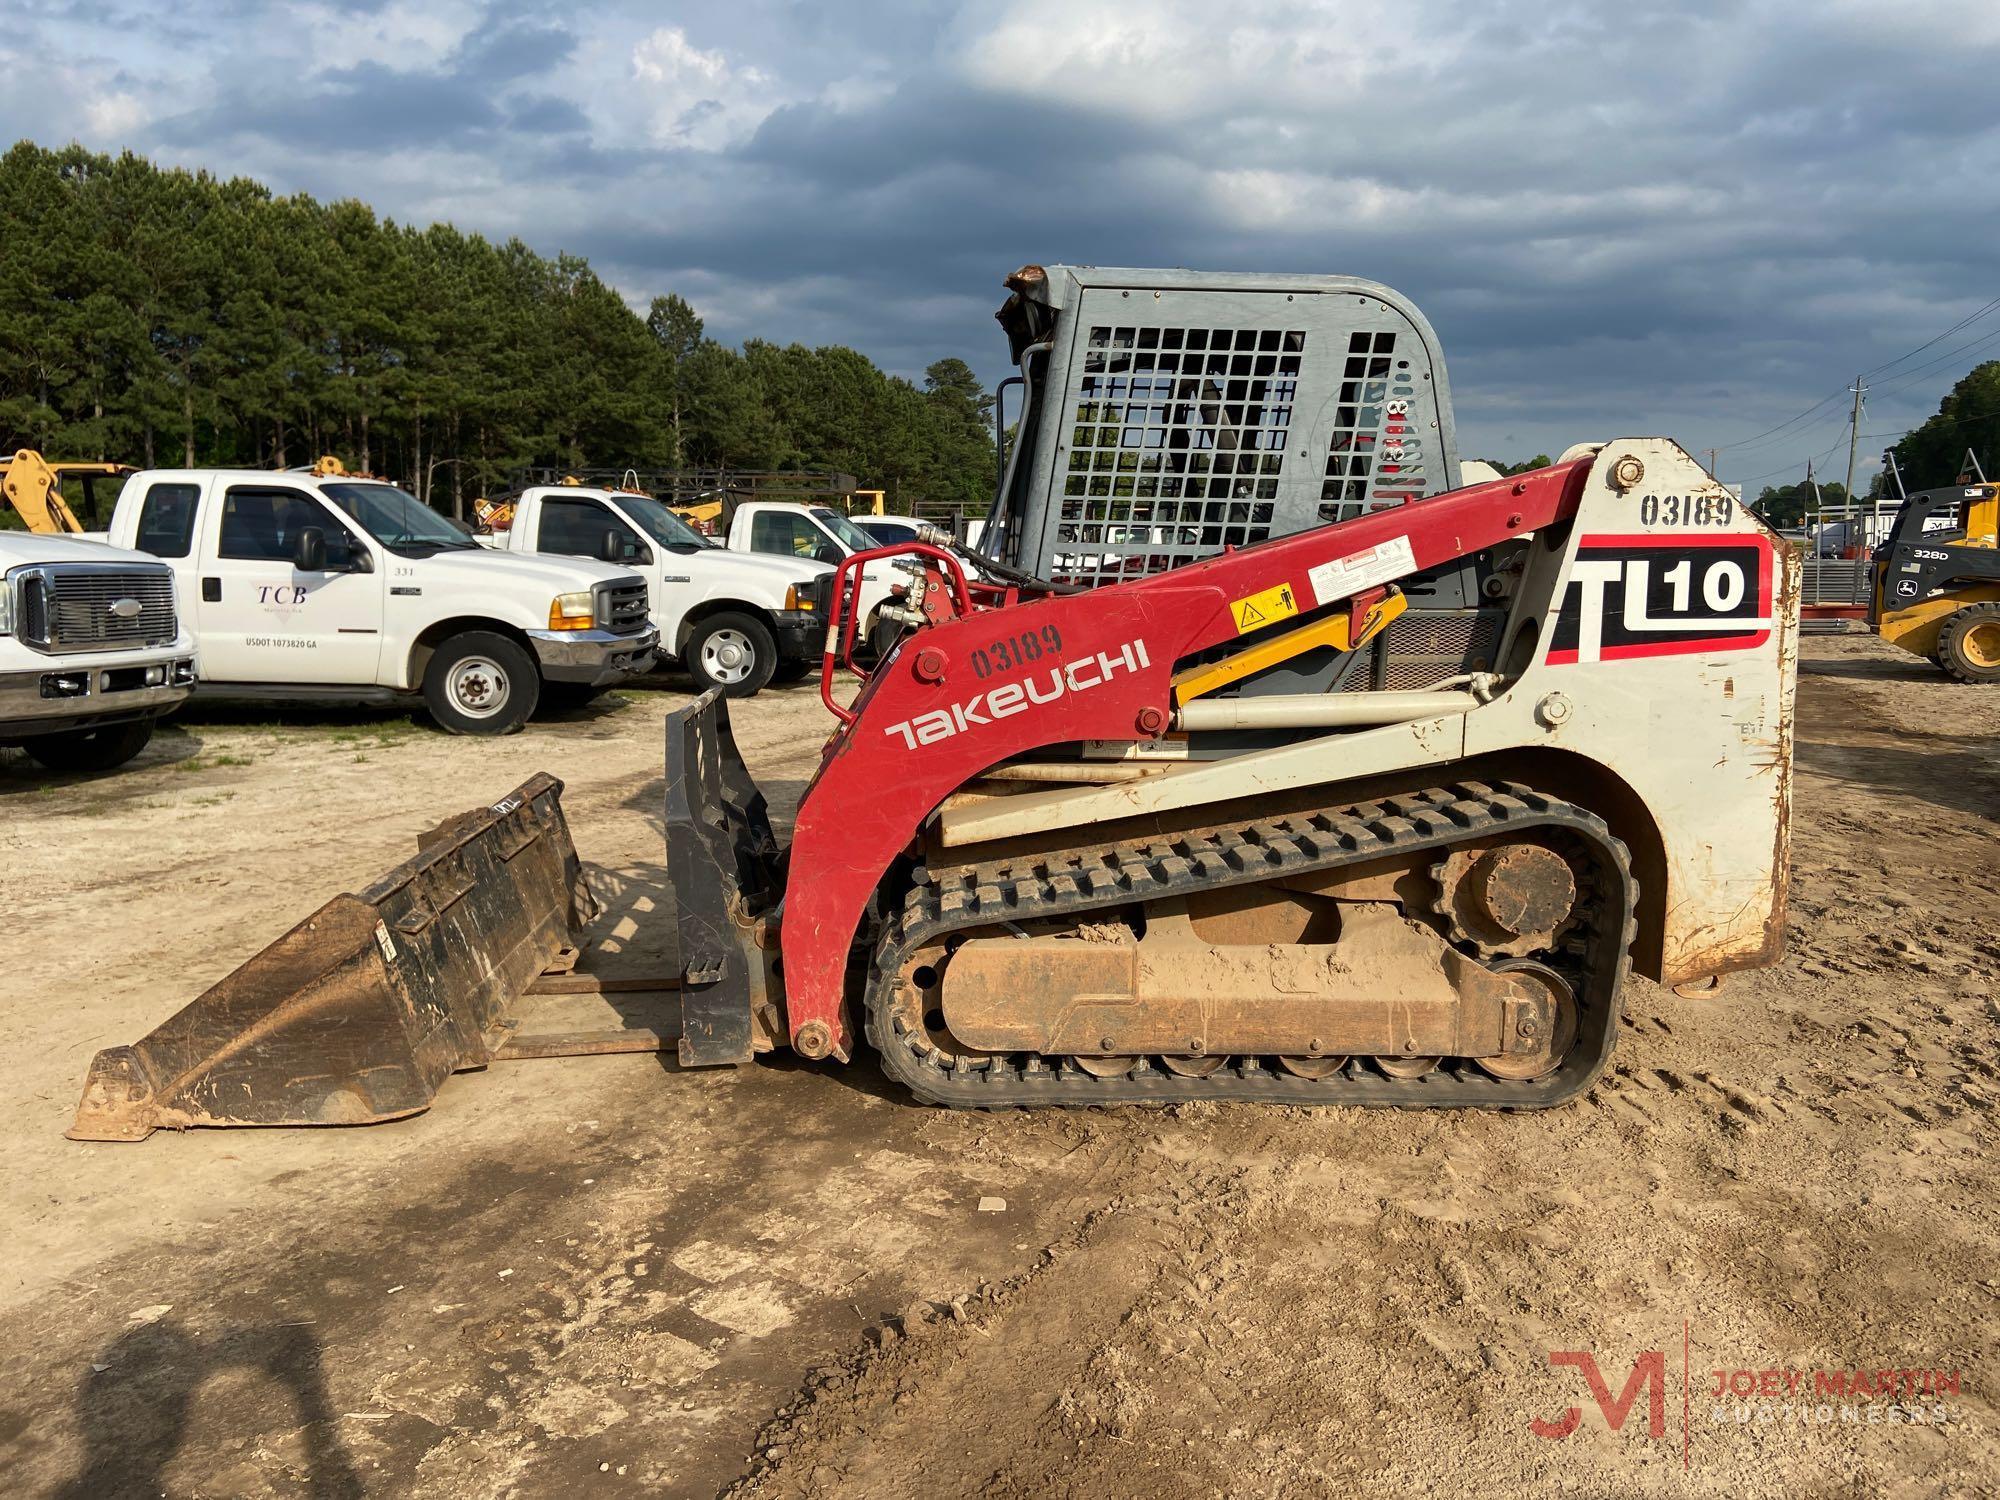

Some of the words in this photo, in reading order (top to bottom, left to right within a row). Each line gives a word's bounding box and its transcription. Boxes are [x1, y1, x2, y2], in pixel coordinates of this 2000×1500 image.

[1640, 495, 1733, 527] 03189
[1913, 549, 1949, 561] 328D
[394, 567, 414, 577] 331
[258, 586, 307, 604] TCB
[1568, 560, 1772, 663] TL10
[246, 638, 270, 647] USDOT
[273, 639, 305, 648] 1073820
[306, 640, 317, 648] GA
[970, 624, 1063, 680] 03189
